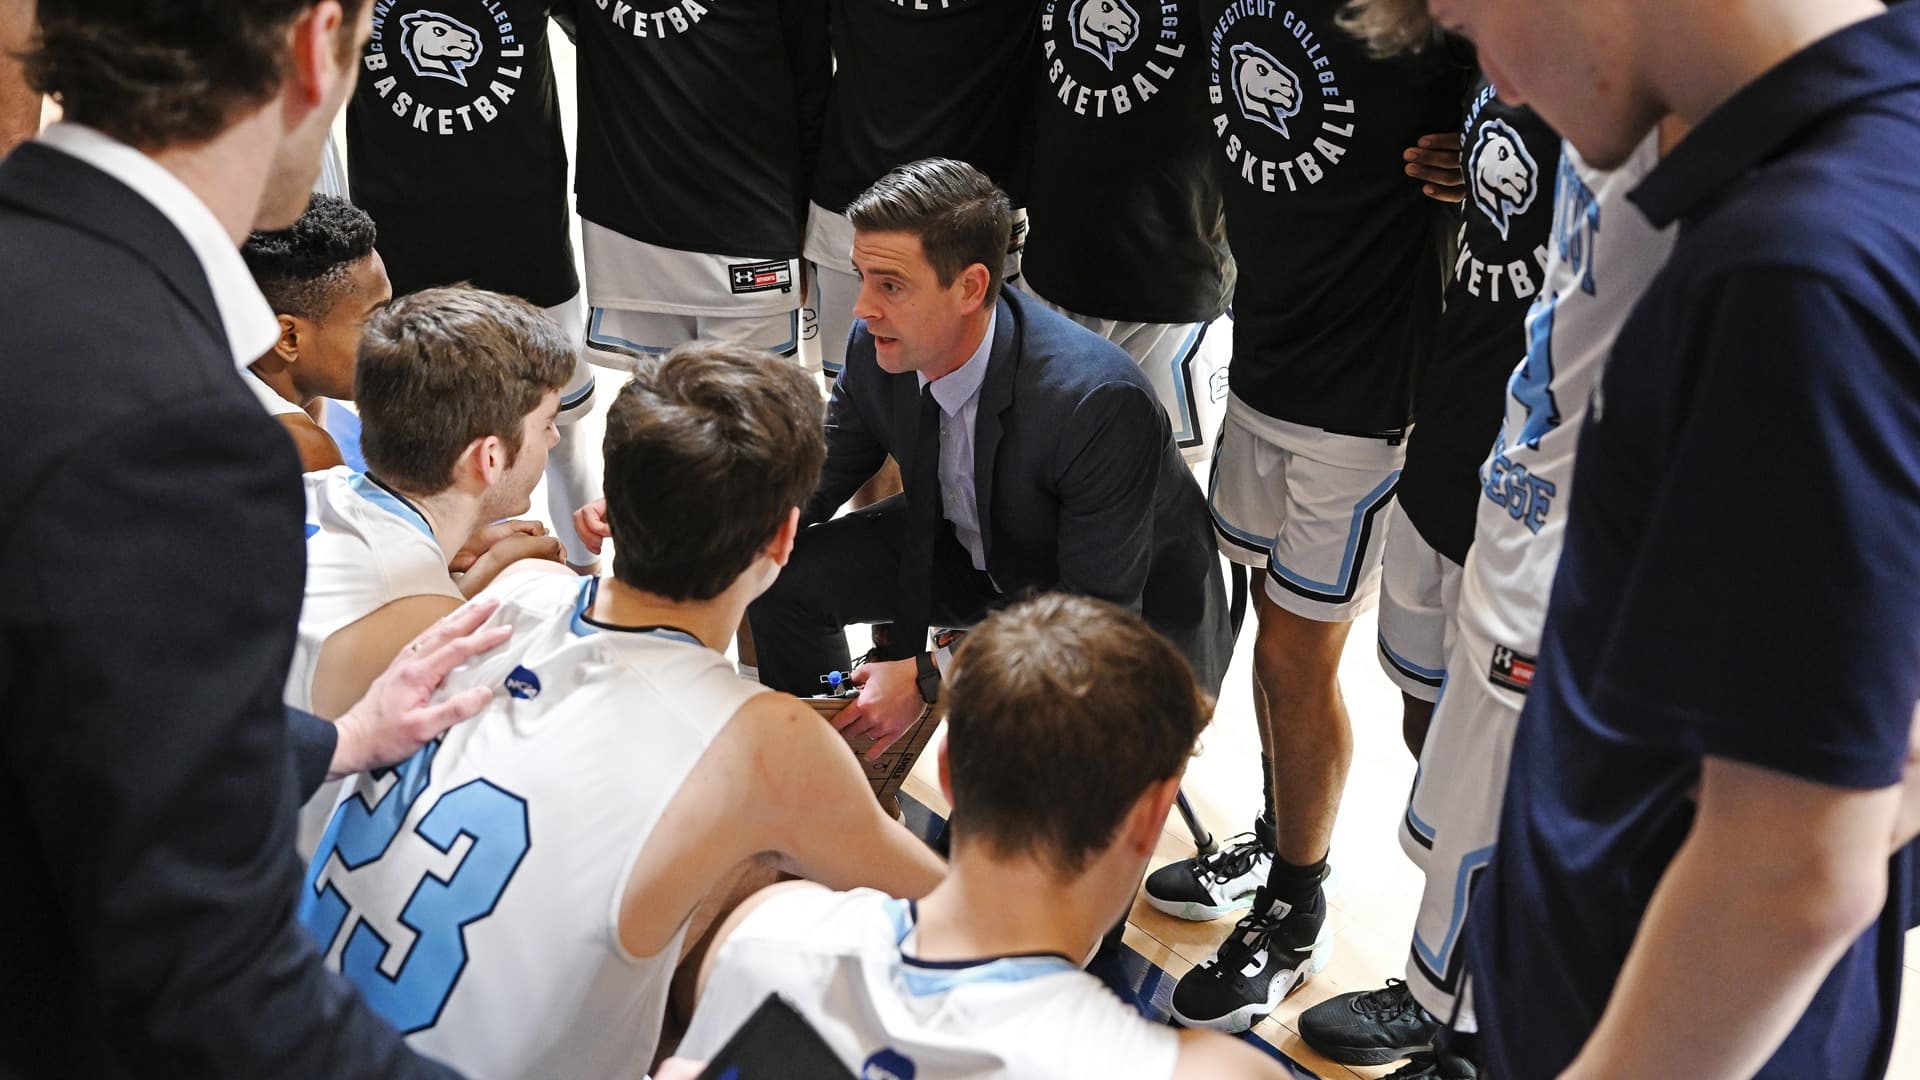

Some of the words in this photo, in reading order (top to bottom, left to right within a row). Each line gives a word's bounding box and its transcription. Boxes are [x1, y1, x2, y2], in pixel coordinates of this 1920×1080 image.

[364, 44, 525, 135] BASKETBALL
[1041, 14, 1186, 118] BASKETBALL
[1211, 0, 1276, 84] CONNECTICUT
[1283, 10, 1339, 97] COLLEGE
[1209, 85, 1355, 192] BASKETBALL
